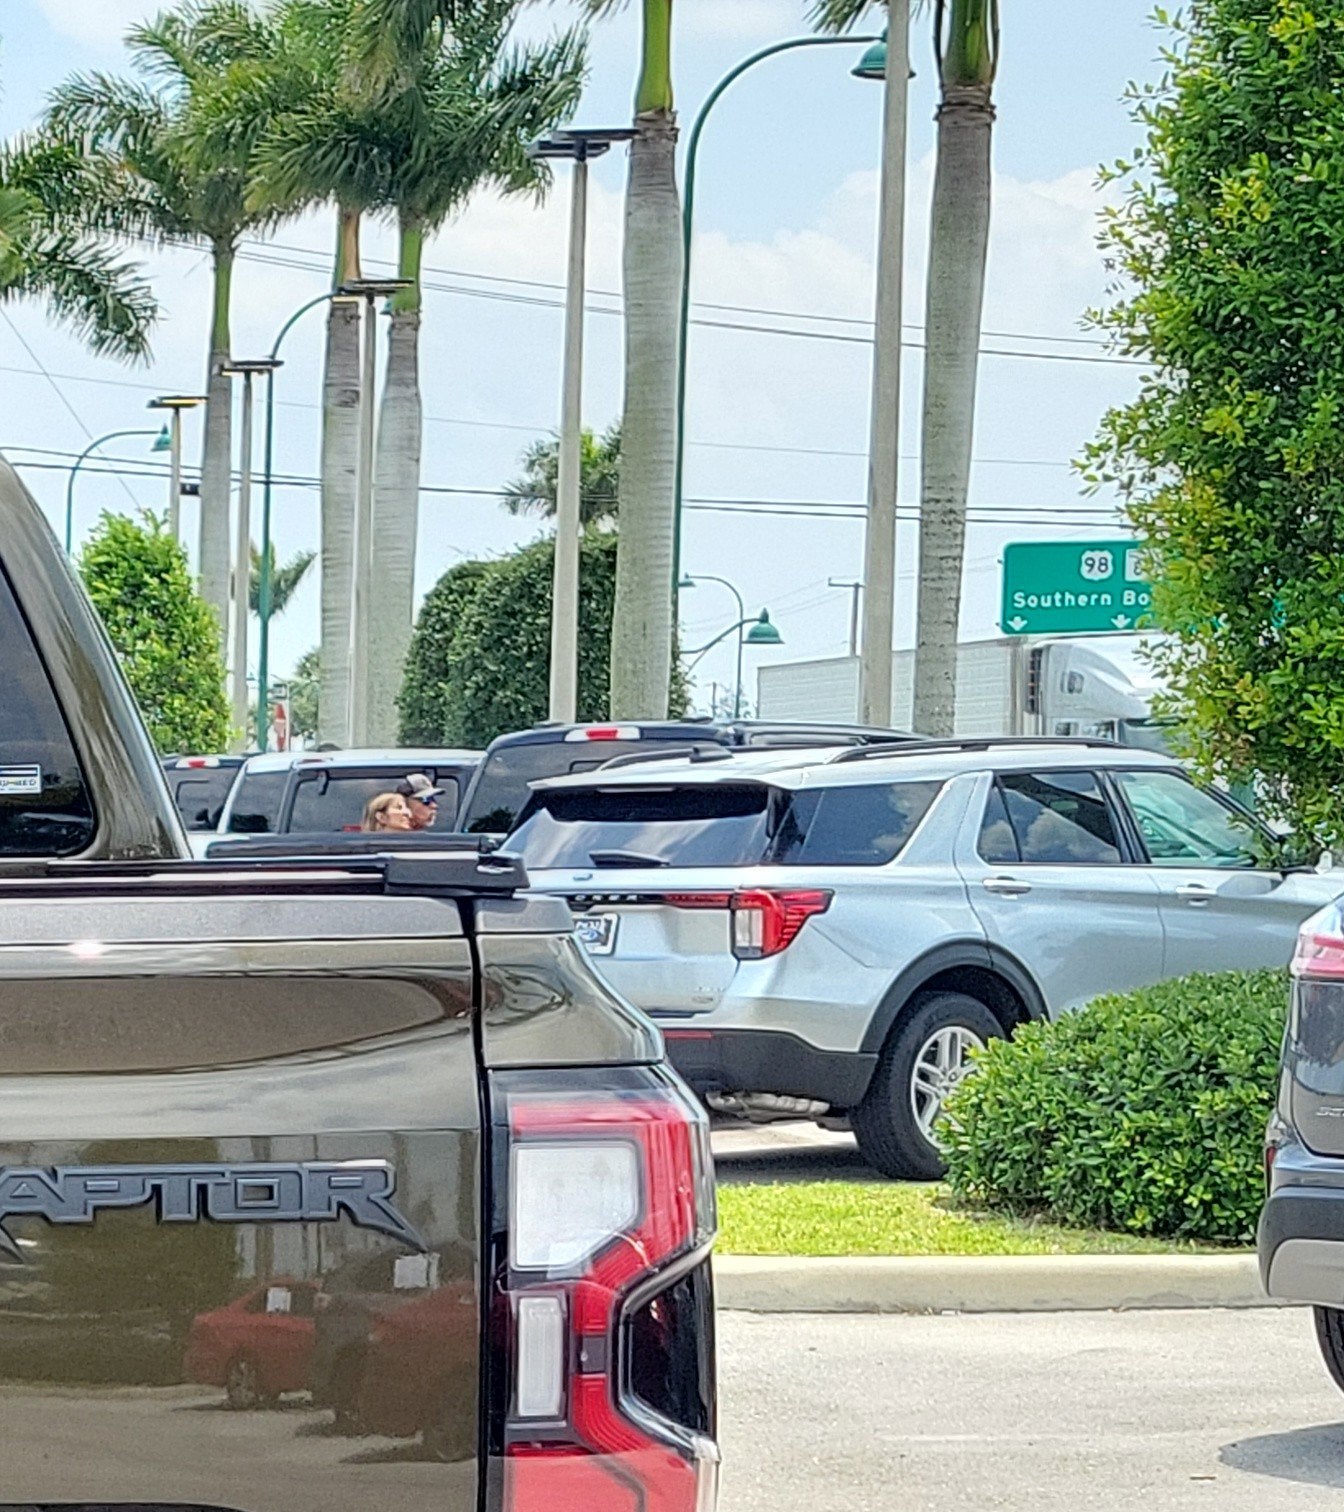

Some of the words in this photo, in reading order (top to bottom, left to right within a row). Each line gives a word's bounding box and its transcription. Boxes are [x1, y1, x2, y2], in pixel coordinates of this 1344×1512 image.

[1084, 557, 1109, 574] 98
[1013, 591, 1112, 608] Southern
[1123, 590, 1150, 606] Bo
